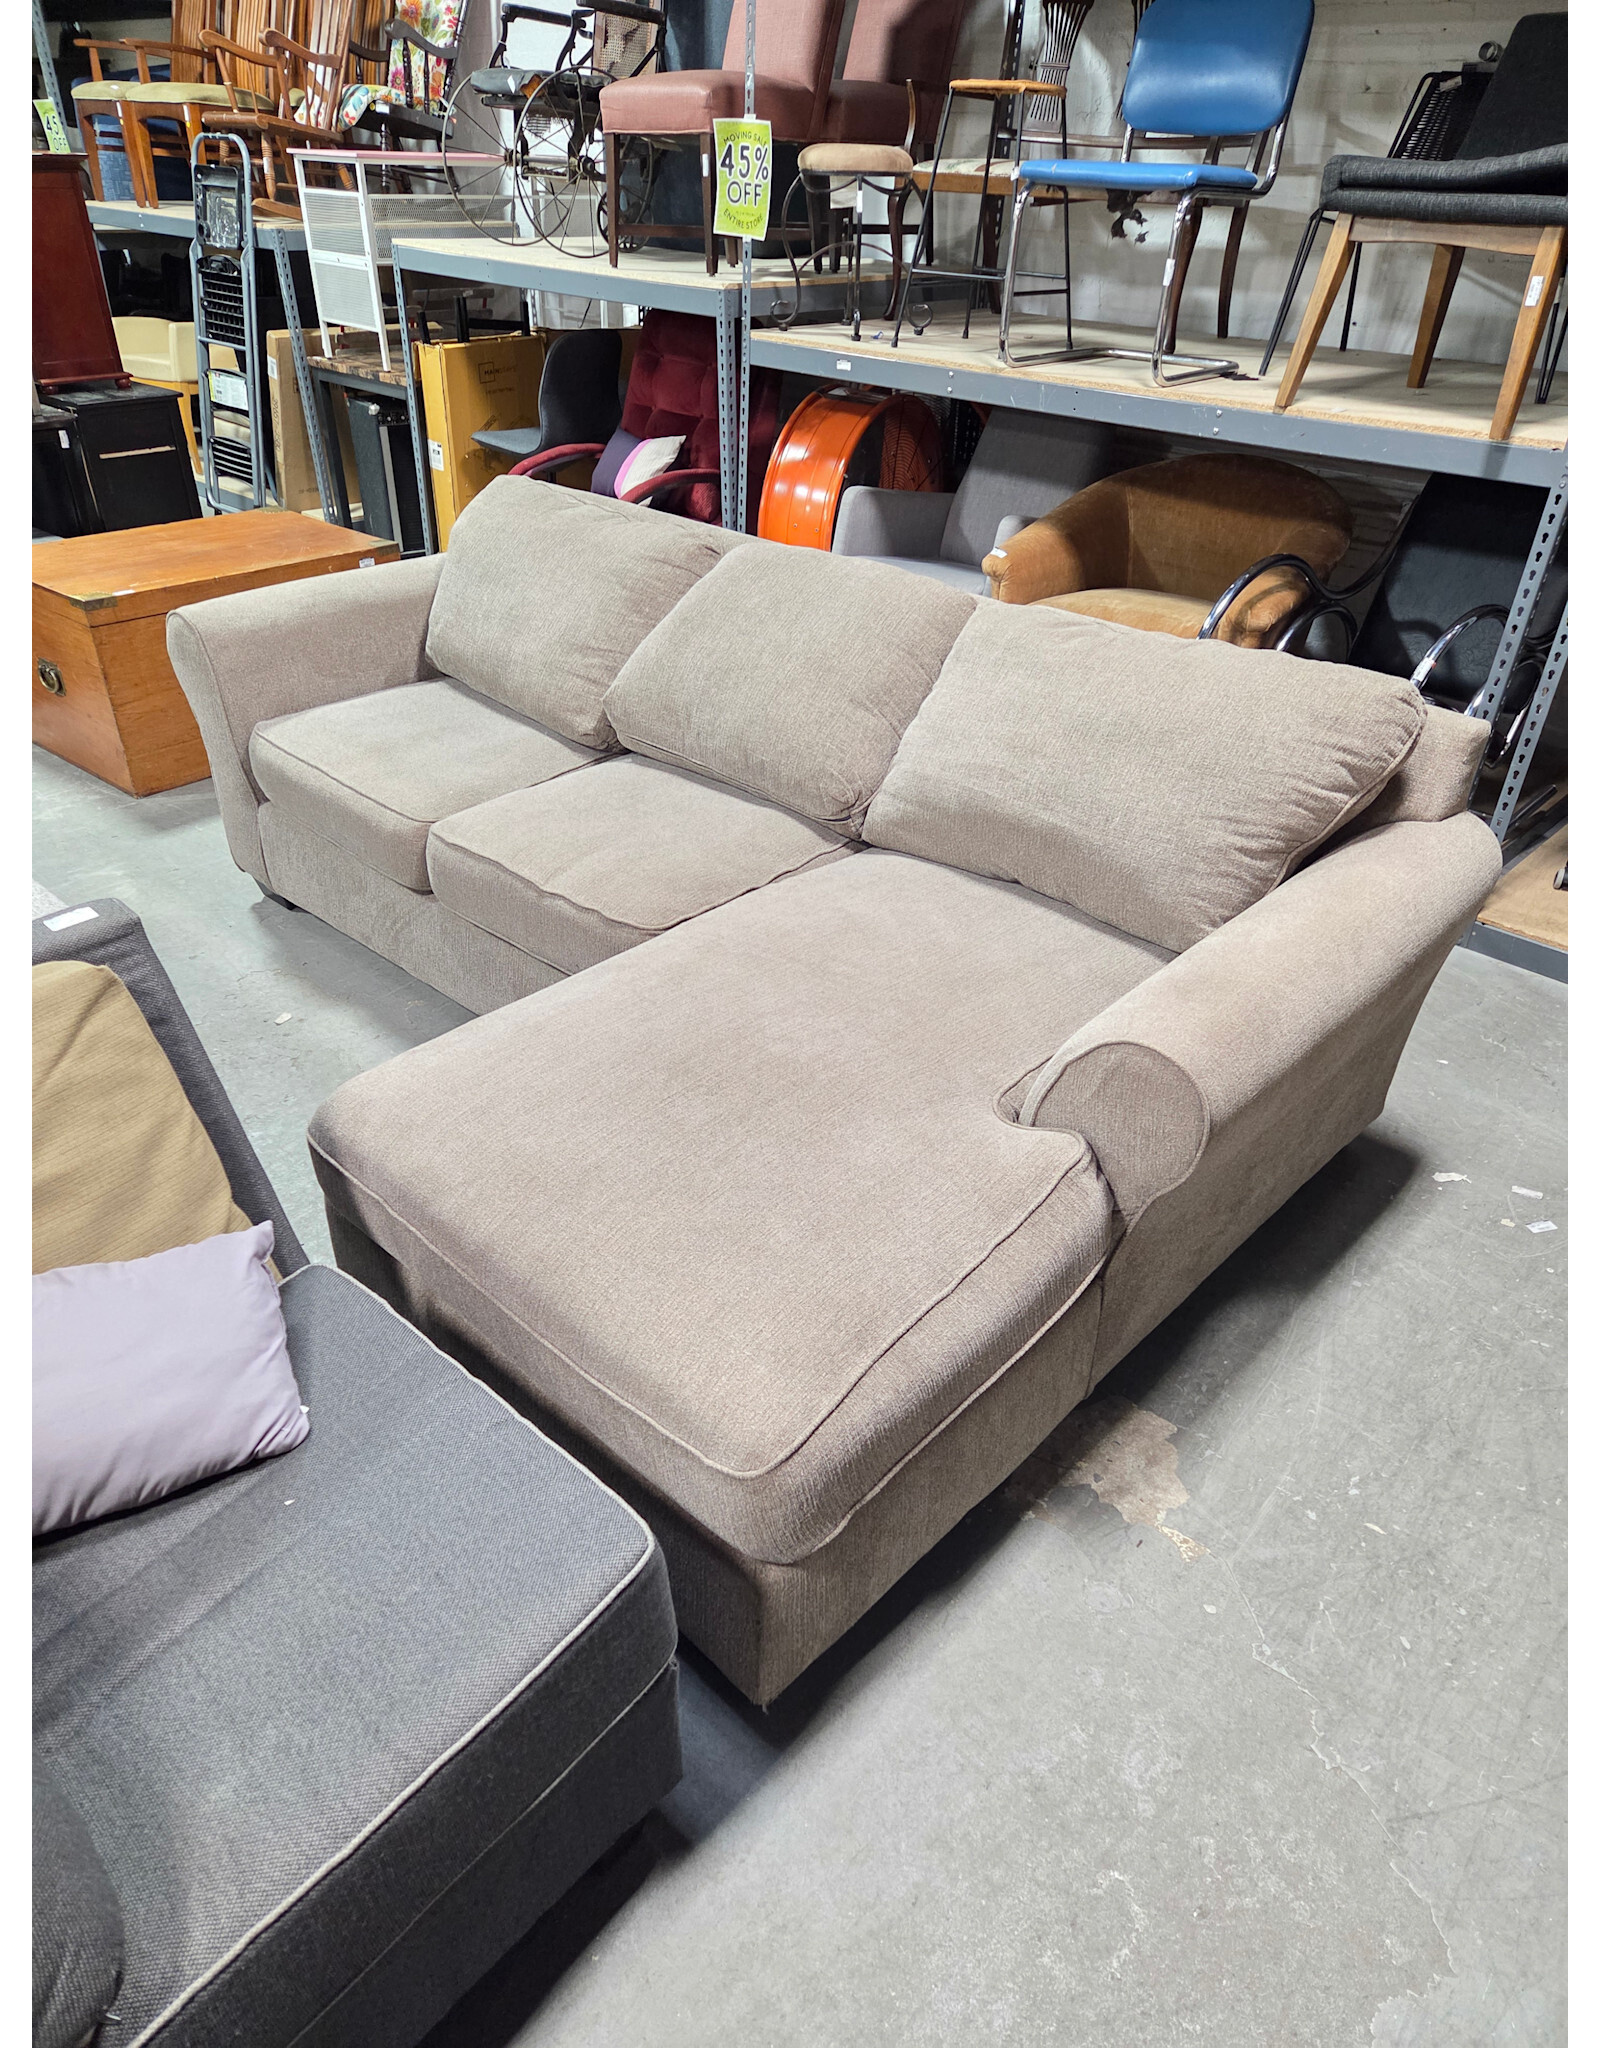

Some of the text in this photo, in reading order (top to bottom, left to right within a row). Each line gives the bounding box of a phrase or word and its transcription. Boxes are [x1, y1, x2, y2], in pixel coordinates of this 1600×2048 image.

[723, 130, 752, 145] MOVING
[720, 143, 769, 180] 45%
[727, 181, 762, 206] OFF
[723, 208, 763, 230] ENTIRE STORE
